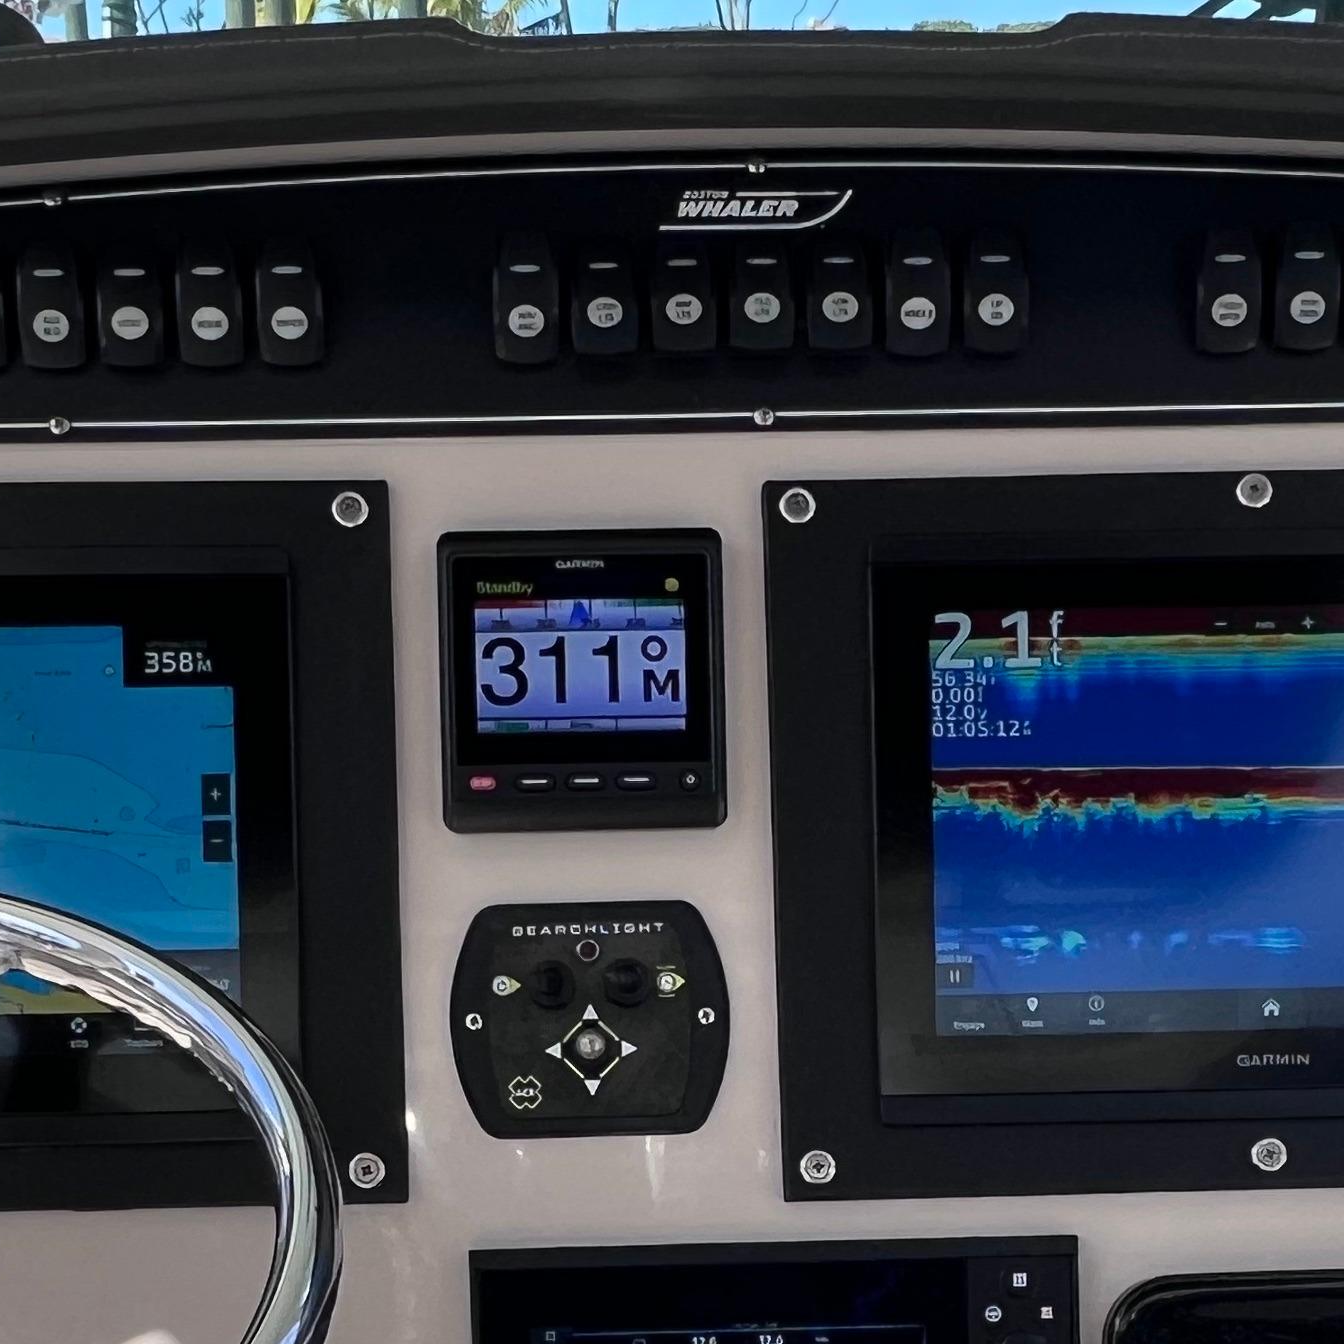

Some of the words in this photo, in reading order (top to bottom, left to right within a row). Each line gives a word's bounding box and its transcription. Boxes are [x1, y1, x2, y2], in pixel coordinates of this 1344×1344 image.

[678, 200, 799, 217] WHALER
[476, 581, 533, 596] Standby
[1236, 1054, 1310, 1067] GARMIN
